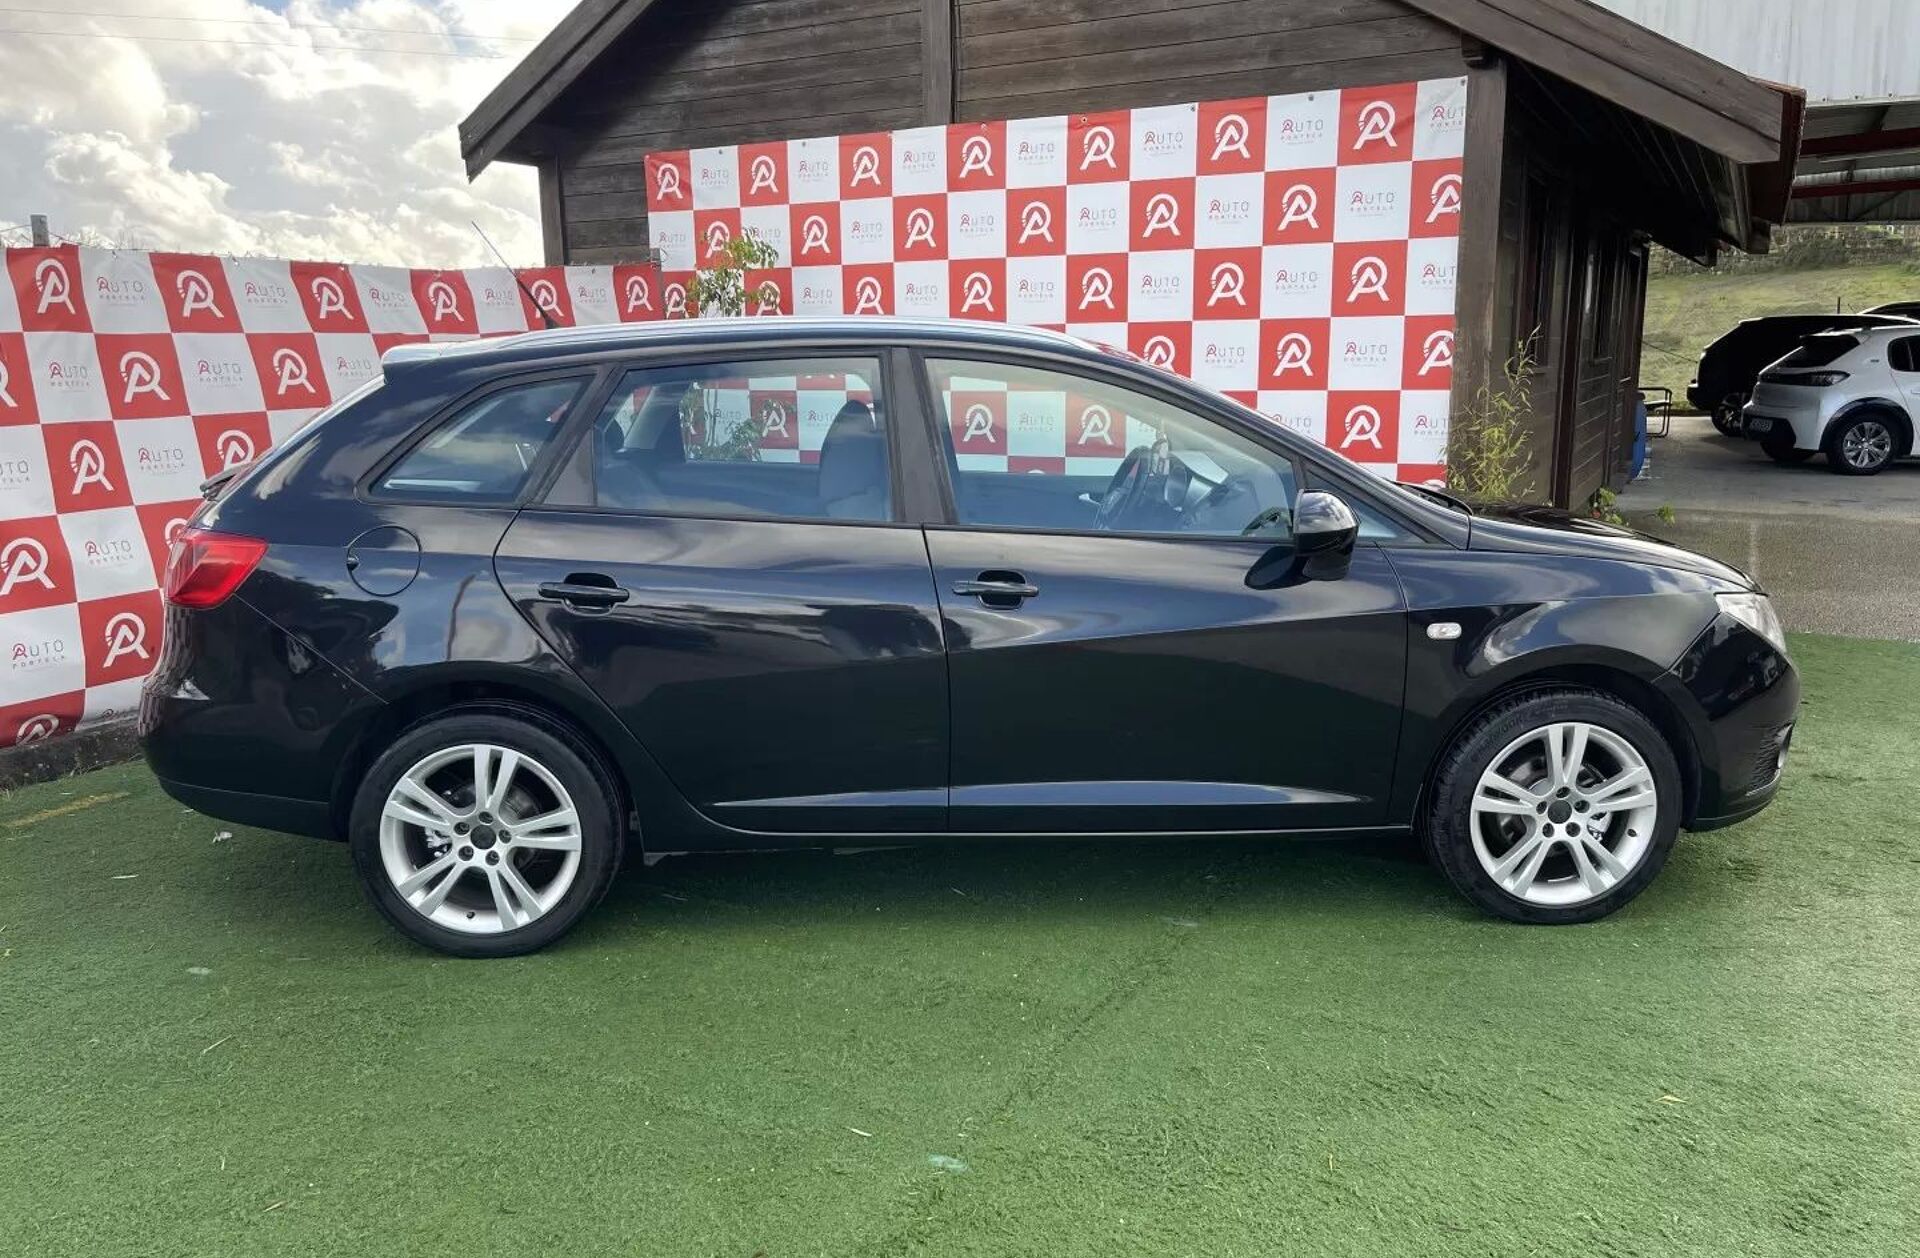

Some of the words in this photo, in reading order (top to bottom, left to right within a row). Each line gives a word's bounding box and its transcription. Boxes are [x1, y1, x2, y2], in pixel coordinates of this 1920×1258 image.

[1281, 119, 1324, 133] AUTO
[1144, 130, 1184, 145] AUTO
[1018, 142, 1054, 154] AUTO
[903, 151, 936, 163] AUTO
[800, 161, 829, 173] AUTO
[1352, 191, 1395, 204] AUTO
[1209, 200, 1249, 213] AUTO
[961, 213, 994, 226] AUTO
[1080, 207, 1116, 221] AUTO
[1142, 275, 1179, 288] AUTO
[1276, 269, 1318, 283] AUTO
[97, 276, 143, 292] AUTO
[244, 282, 286, 296] AUTO
[906, 283, 938, 295] AUTO
[1019, 279, 1054, 292] AUTO
[1206, 344, 1245, 357] AUTO
[1345, 342, 1387, 355] AUTO
[49, 361, 87, 379] AUTO
[198, 360, 241, 375] AUTO
[138, 448, 183, 463] AUTO
[85, 540, 131, 556] AUTO
[13, 639, 64, 660] AUTO
